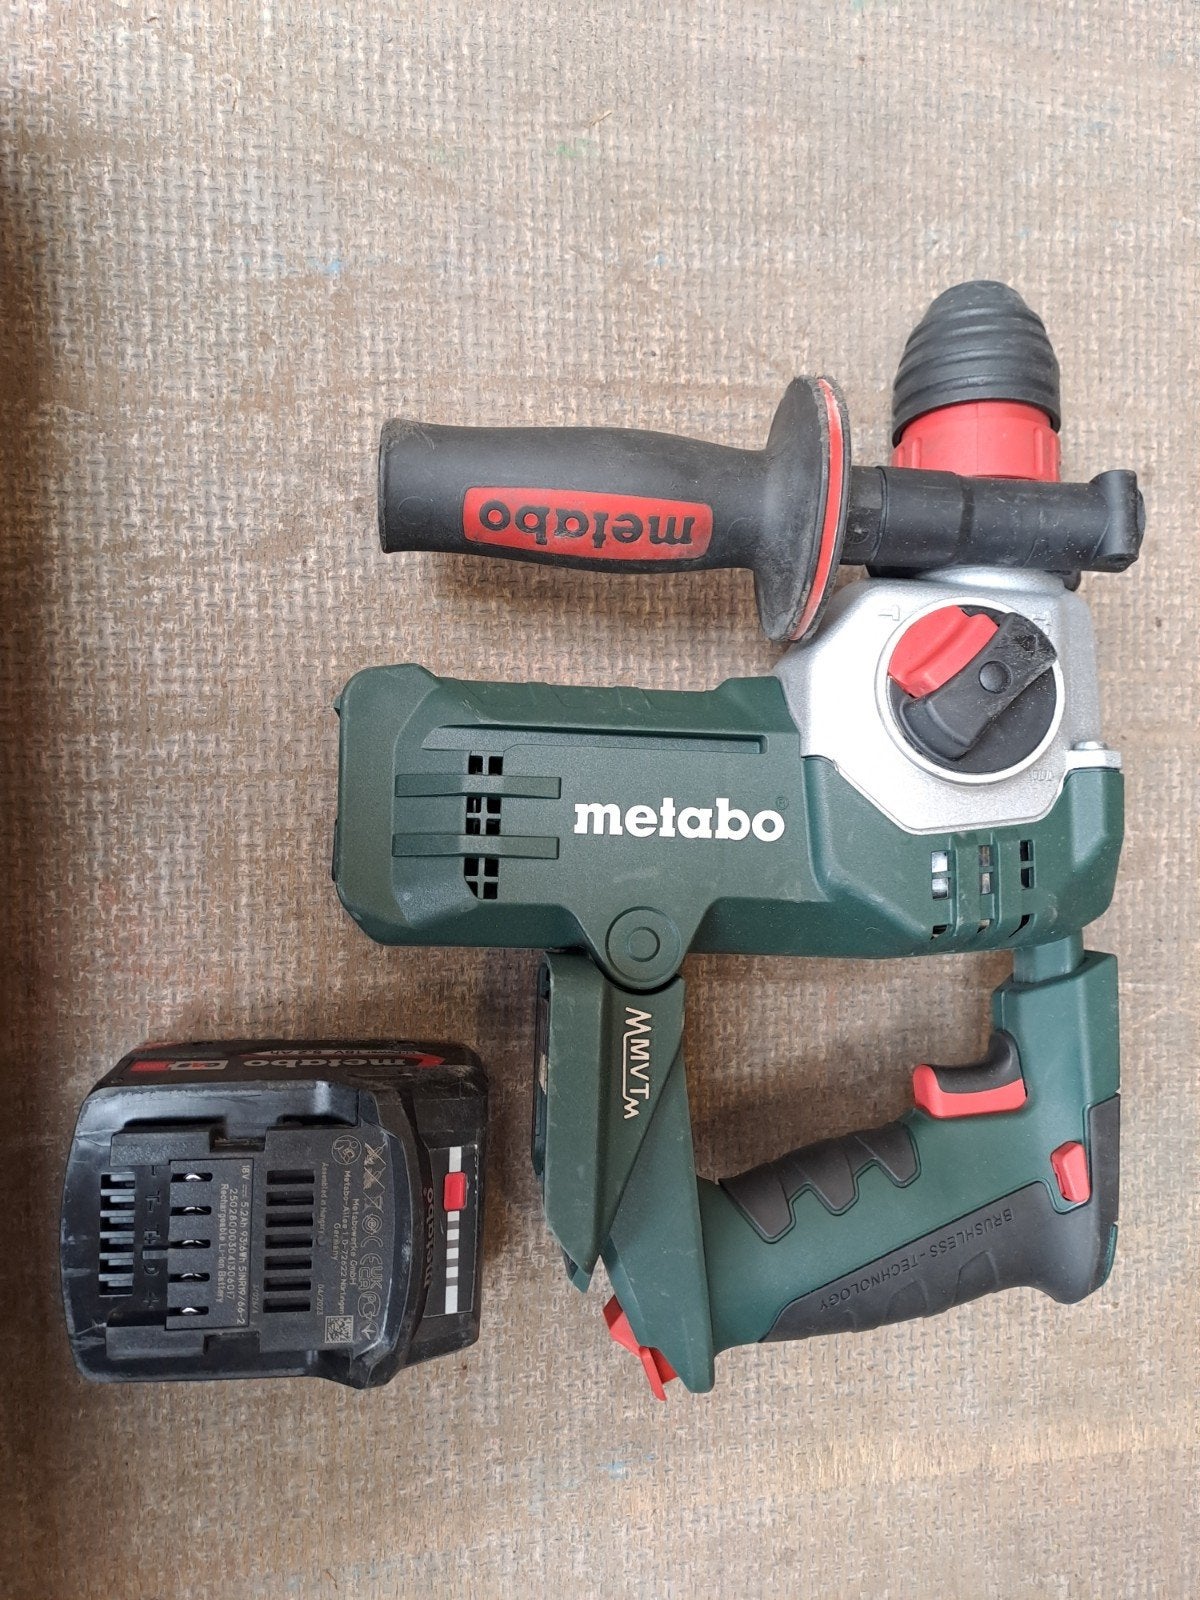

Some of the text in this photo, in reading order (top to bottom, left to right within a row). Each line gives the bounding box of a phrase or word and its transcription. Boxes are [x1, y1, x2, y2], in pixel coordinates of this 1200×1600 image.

[479, 499, 696, 549] metabo
[574, 797, 785, 842] metabo
[243, 1058, 406, 1068] metabo
[241, 1164, 250, 1180] 18V
[320, 1162, 329, 1198] Assembled
[217, 1183, 229, 1241] Rechargeable
[239, 1201, 249, 1228] 5.2Ah
[341, 1170, 351, 1229] Metabo-Allee
[317, 1207, 327, 1235] Hungary
[331, 1222, 341, 1261] Germany
[340, 1239, 348, 1277] D-72622
[349, 1198, 360, 1285] Metabowerke GmbH
[215, 1270, 226, 1303] Battery
[316, 1284, 325, 1316] 04/2023
